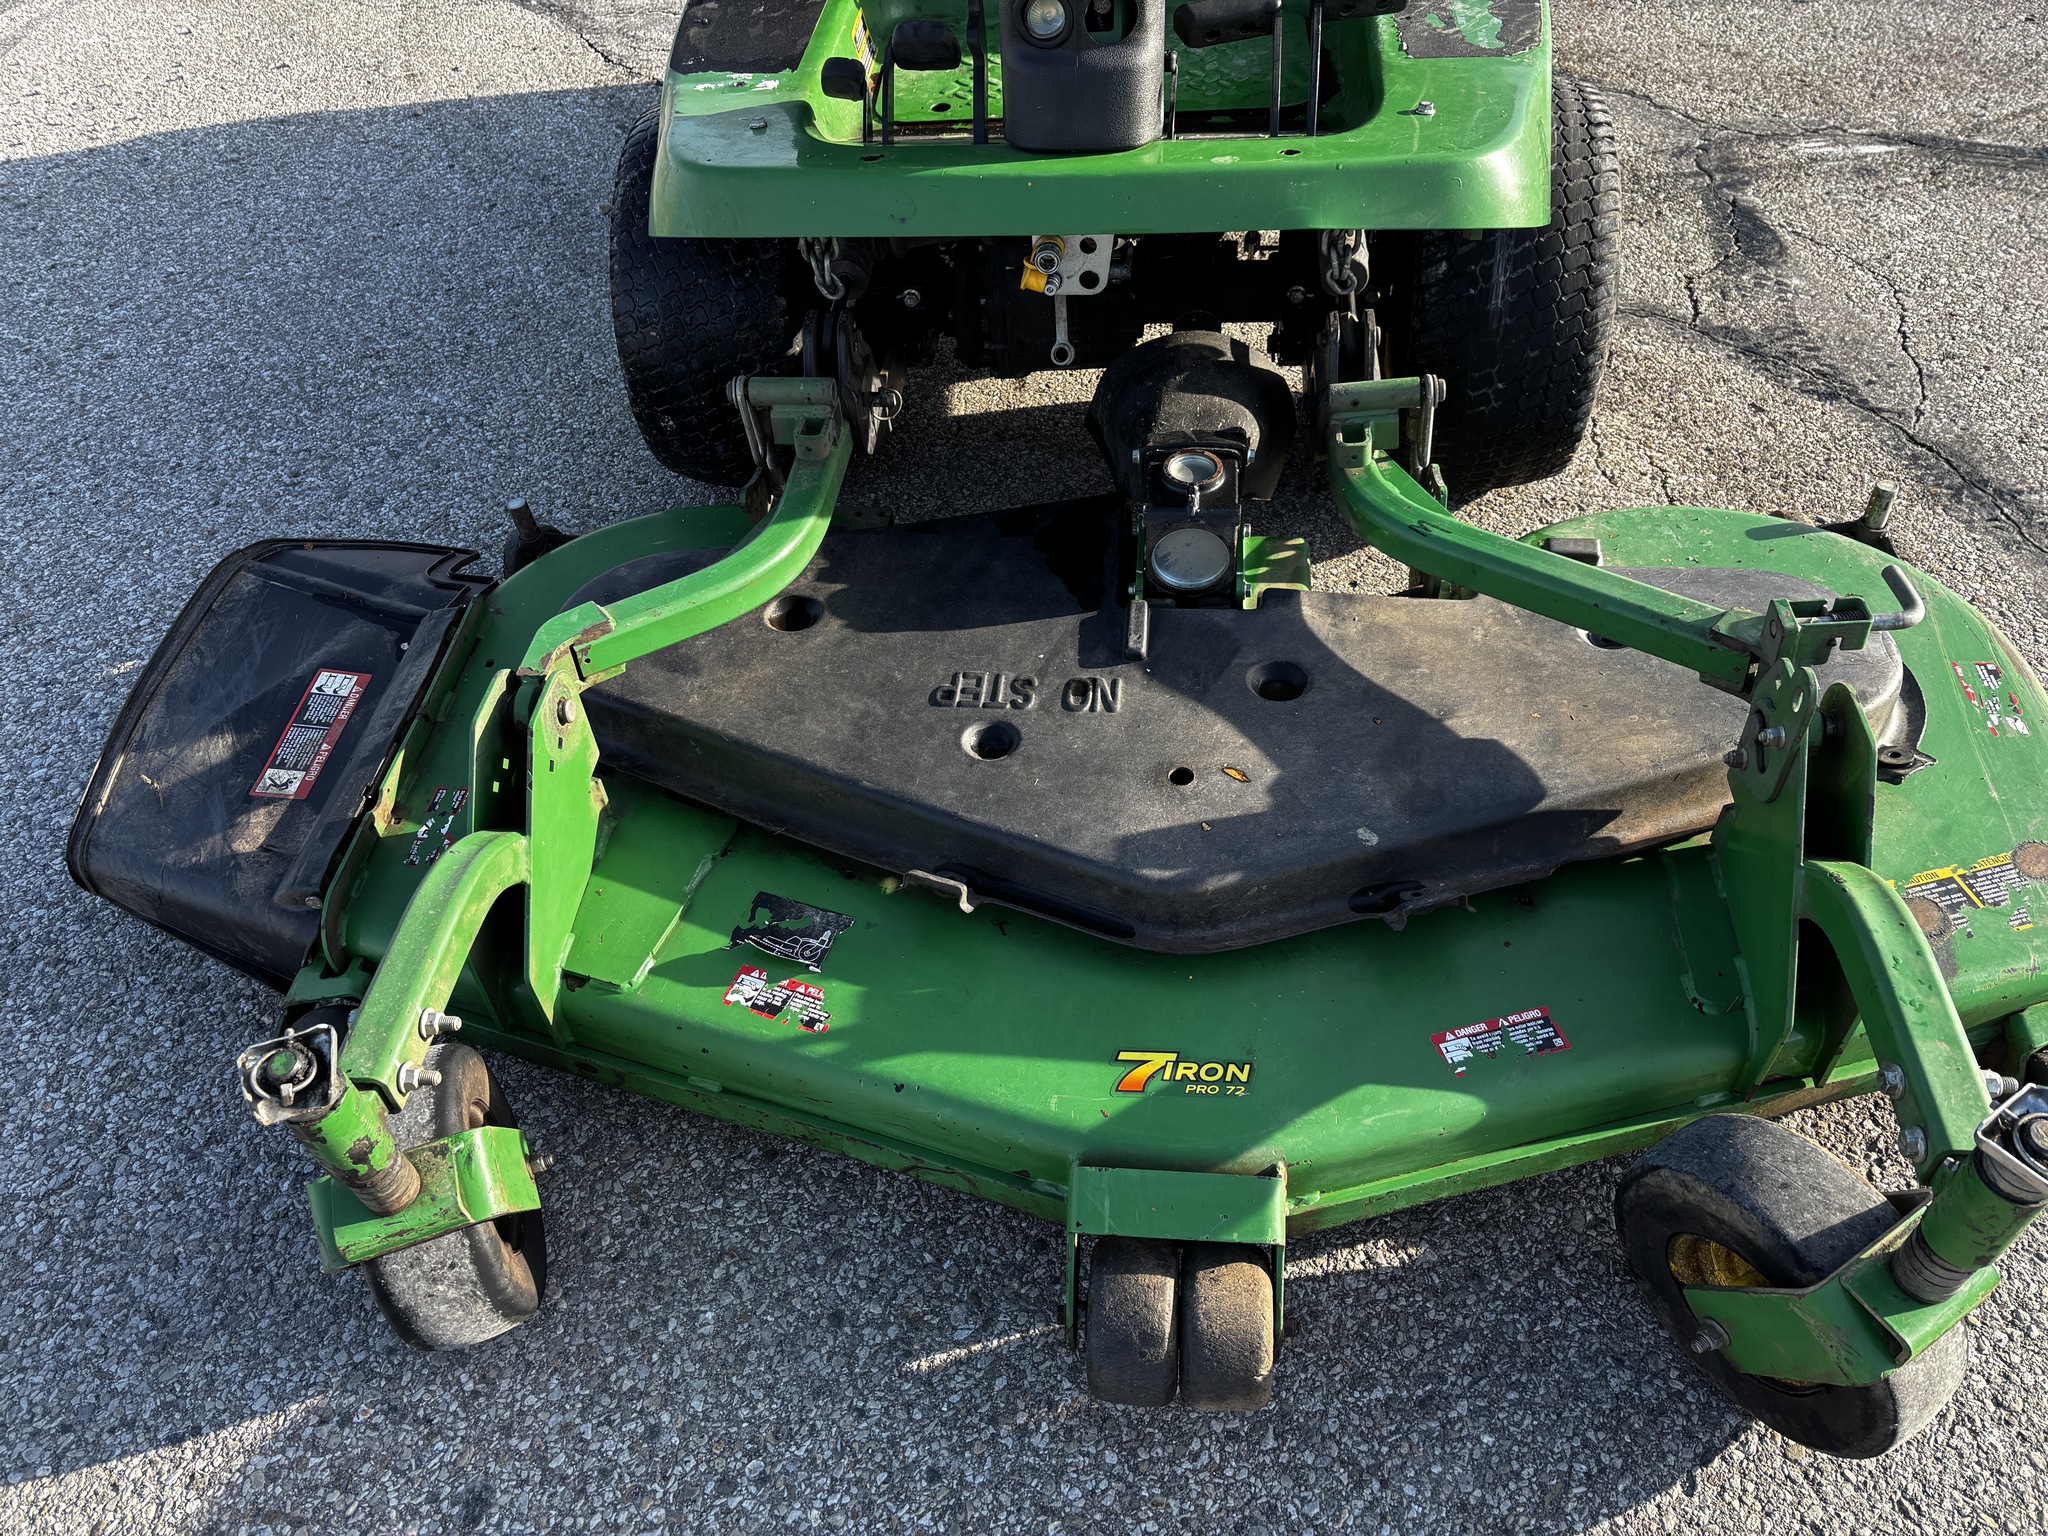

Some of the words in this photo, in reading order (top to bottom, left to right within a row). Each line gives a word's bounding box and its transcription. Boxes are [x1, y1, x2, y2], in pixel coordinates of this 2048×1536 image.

[928, 671, 1038, 710] STEP
[1061, 676, 1122, 713] NO
[338, 693, 359, 720] DANGER
[306, 752, 328, 781] PELIGRO
[1454, 1022, 1488, 1037] DANGER
[1508, 1009, 1542, 1024] PELIGRO
[1116, 1051, 1179, 1091] 7
[1162, 1061, 1251, 1082] IRON
[1185, 1084, 1220, 1095] PRO
[1225, 1085, 1246, 1095] 72
